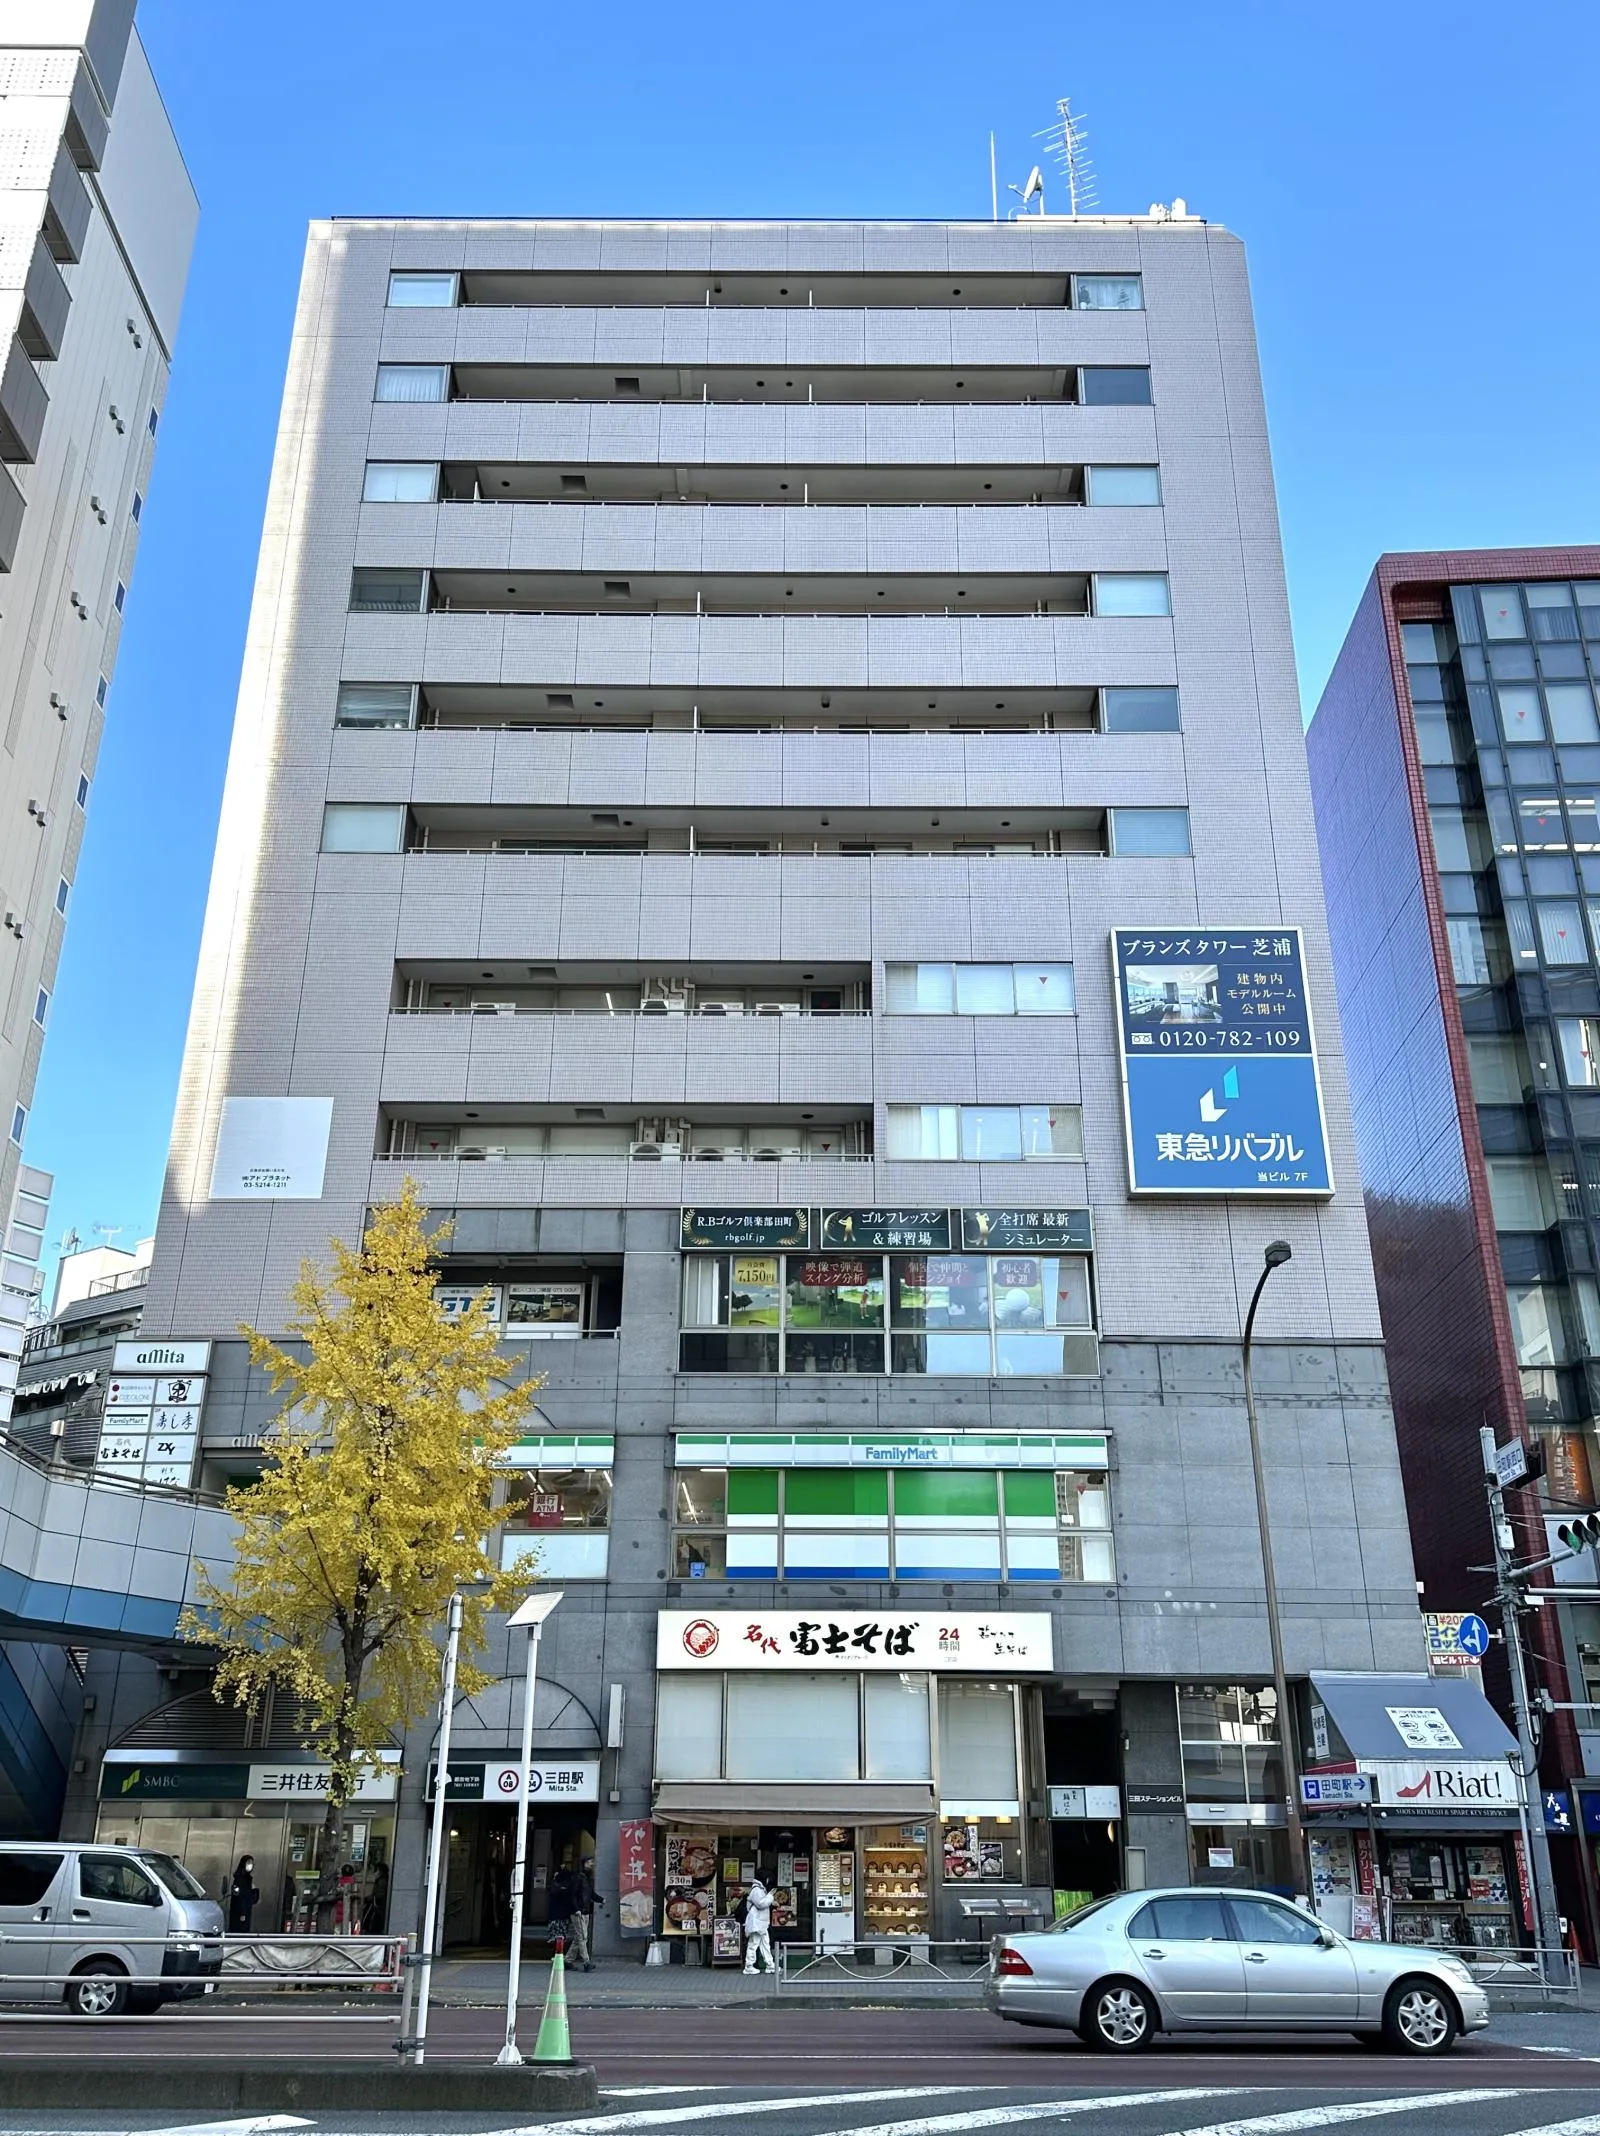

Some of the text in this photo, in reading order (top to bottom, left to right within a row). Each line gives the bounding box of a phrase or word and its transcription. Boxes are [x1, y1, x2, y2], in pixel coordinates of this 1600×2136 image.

[1237, 973, 1283, 985] 建物内
[1227, 989, 1296, 999] モデルルーム
[1242, 1003, 1286, 1015] 公開中
[1159, 1031, 1300, 1047] 0120-782-109
[1156, 1132, 1304, 1162] 東急リバブル
[1257, 1172, 1308, 1182] 当ビル 7F
[697, 1216, 793, 1227] R.Bゴルフ倶楽部田町
[862, 1211, 941, 1224] ゴルフレッスン
[999, 1212, 1069, 1226] 全打席 最新
[725, 1232, 765, 1243] rbgolf.jp
[872, 1232, 932, 1246] & 練習場
[1004, 1233, 1084, 1246] シミュレーター
[805, 1262, 864, 1273] 映像で弾道
[1001, 1262, 1032, 1274] 初心者
[805, 1273, 864, 1284] スイング分析
[916, 1274, 962, 1284] エンジョイ
[1006, 1274, 1028, 1285] 歓迎
[865, 1446, 938, 1463] FamilyMart
[536, 1495, 556, 1504] 銀行
[743, 1622, 920, 1656] 名代 富士そば
[938, 1628, 960, 1641] 24
[938, 1641, 961, 1652] 時間
[143, 1775, 180, 1788] SMBC
[261, 1773, 366, 1791] 三井住友行
[545, 1772, 584, 1784] 三田駅
[1433, 1770, 1502, 1798] Riat!
[1321, 1779, 1352, 1791] 田町駅
